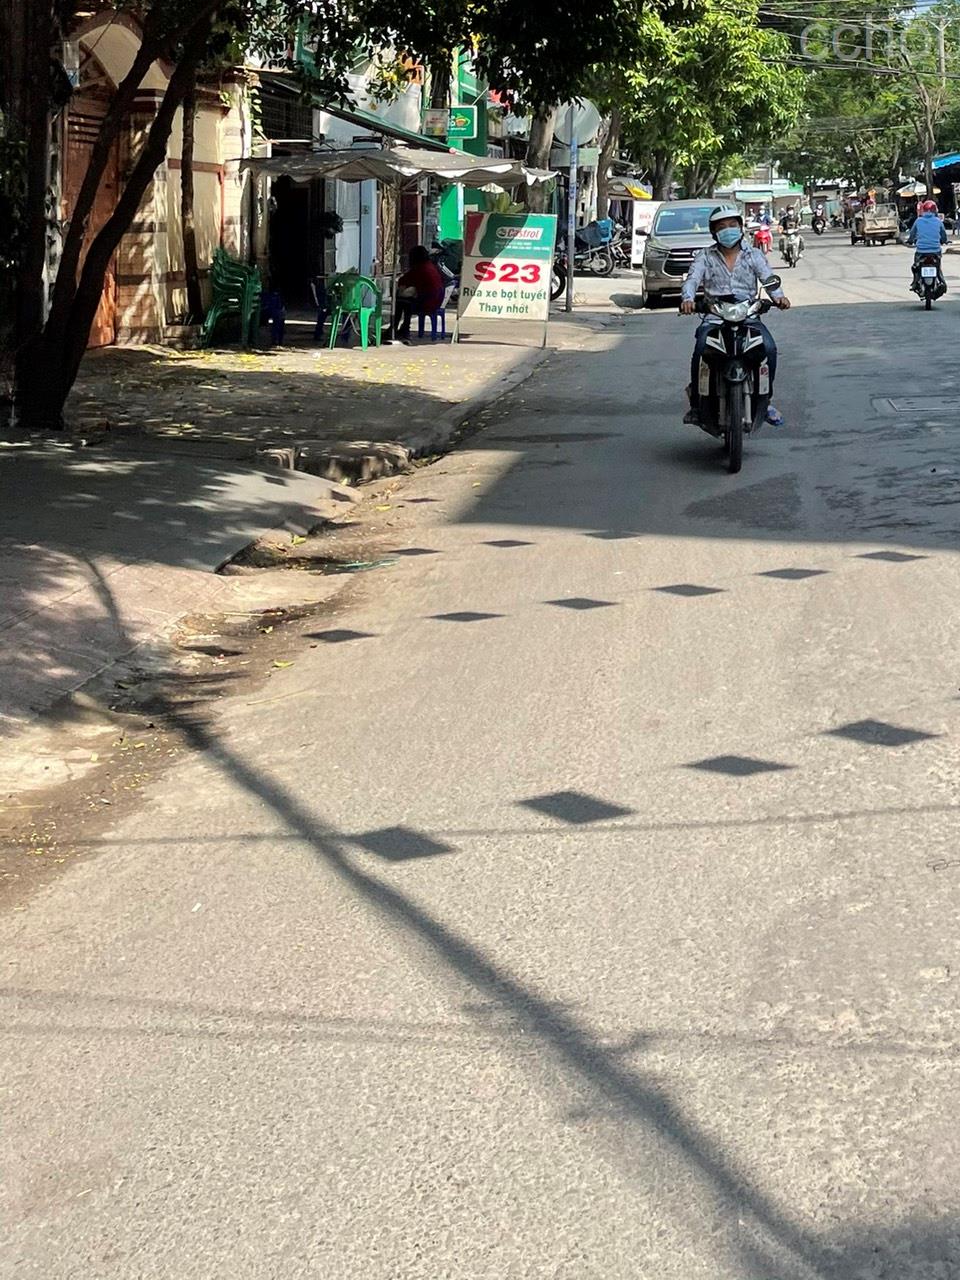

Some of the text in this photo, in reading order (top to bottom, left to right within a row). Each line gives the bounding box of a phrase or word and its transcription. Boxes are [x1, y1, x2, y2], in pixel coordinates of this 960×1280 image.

[507, 228, 540, 239] Castrol
[474, 261, 541, 283] S23
[486, 290, 498, 298] xe
[501, 289, 517, 301] bọt
[479, 302, 503, 314] Thay
